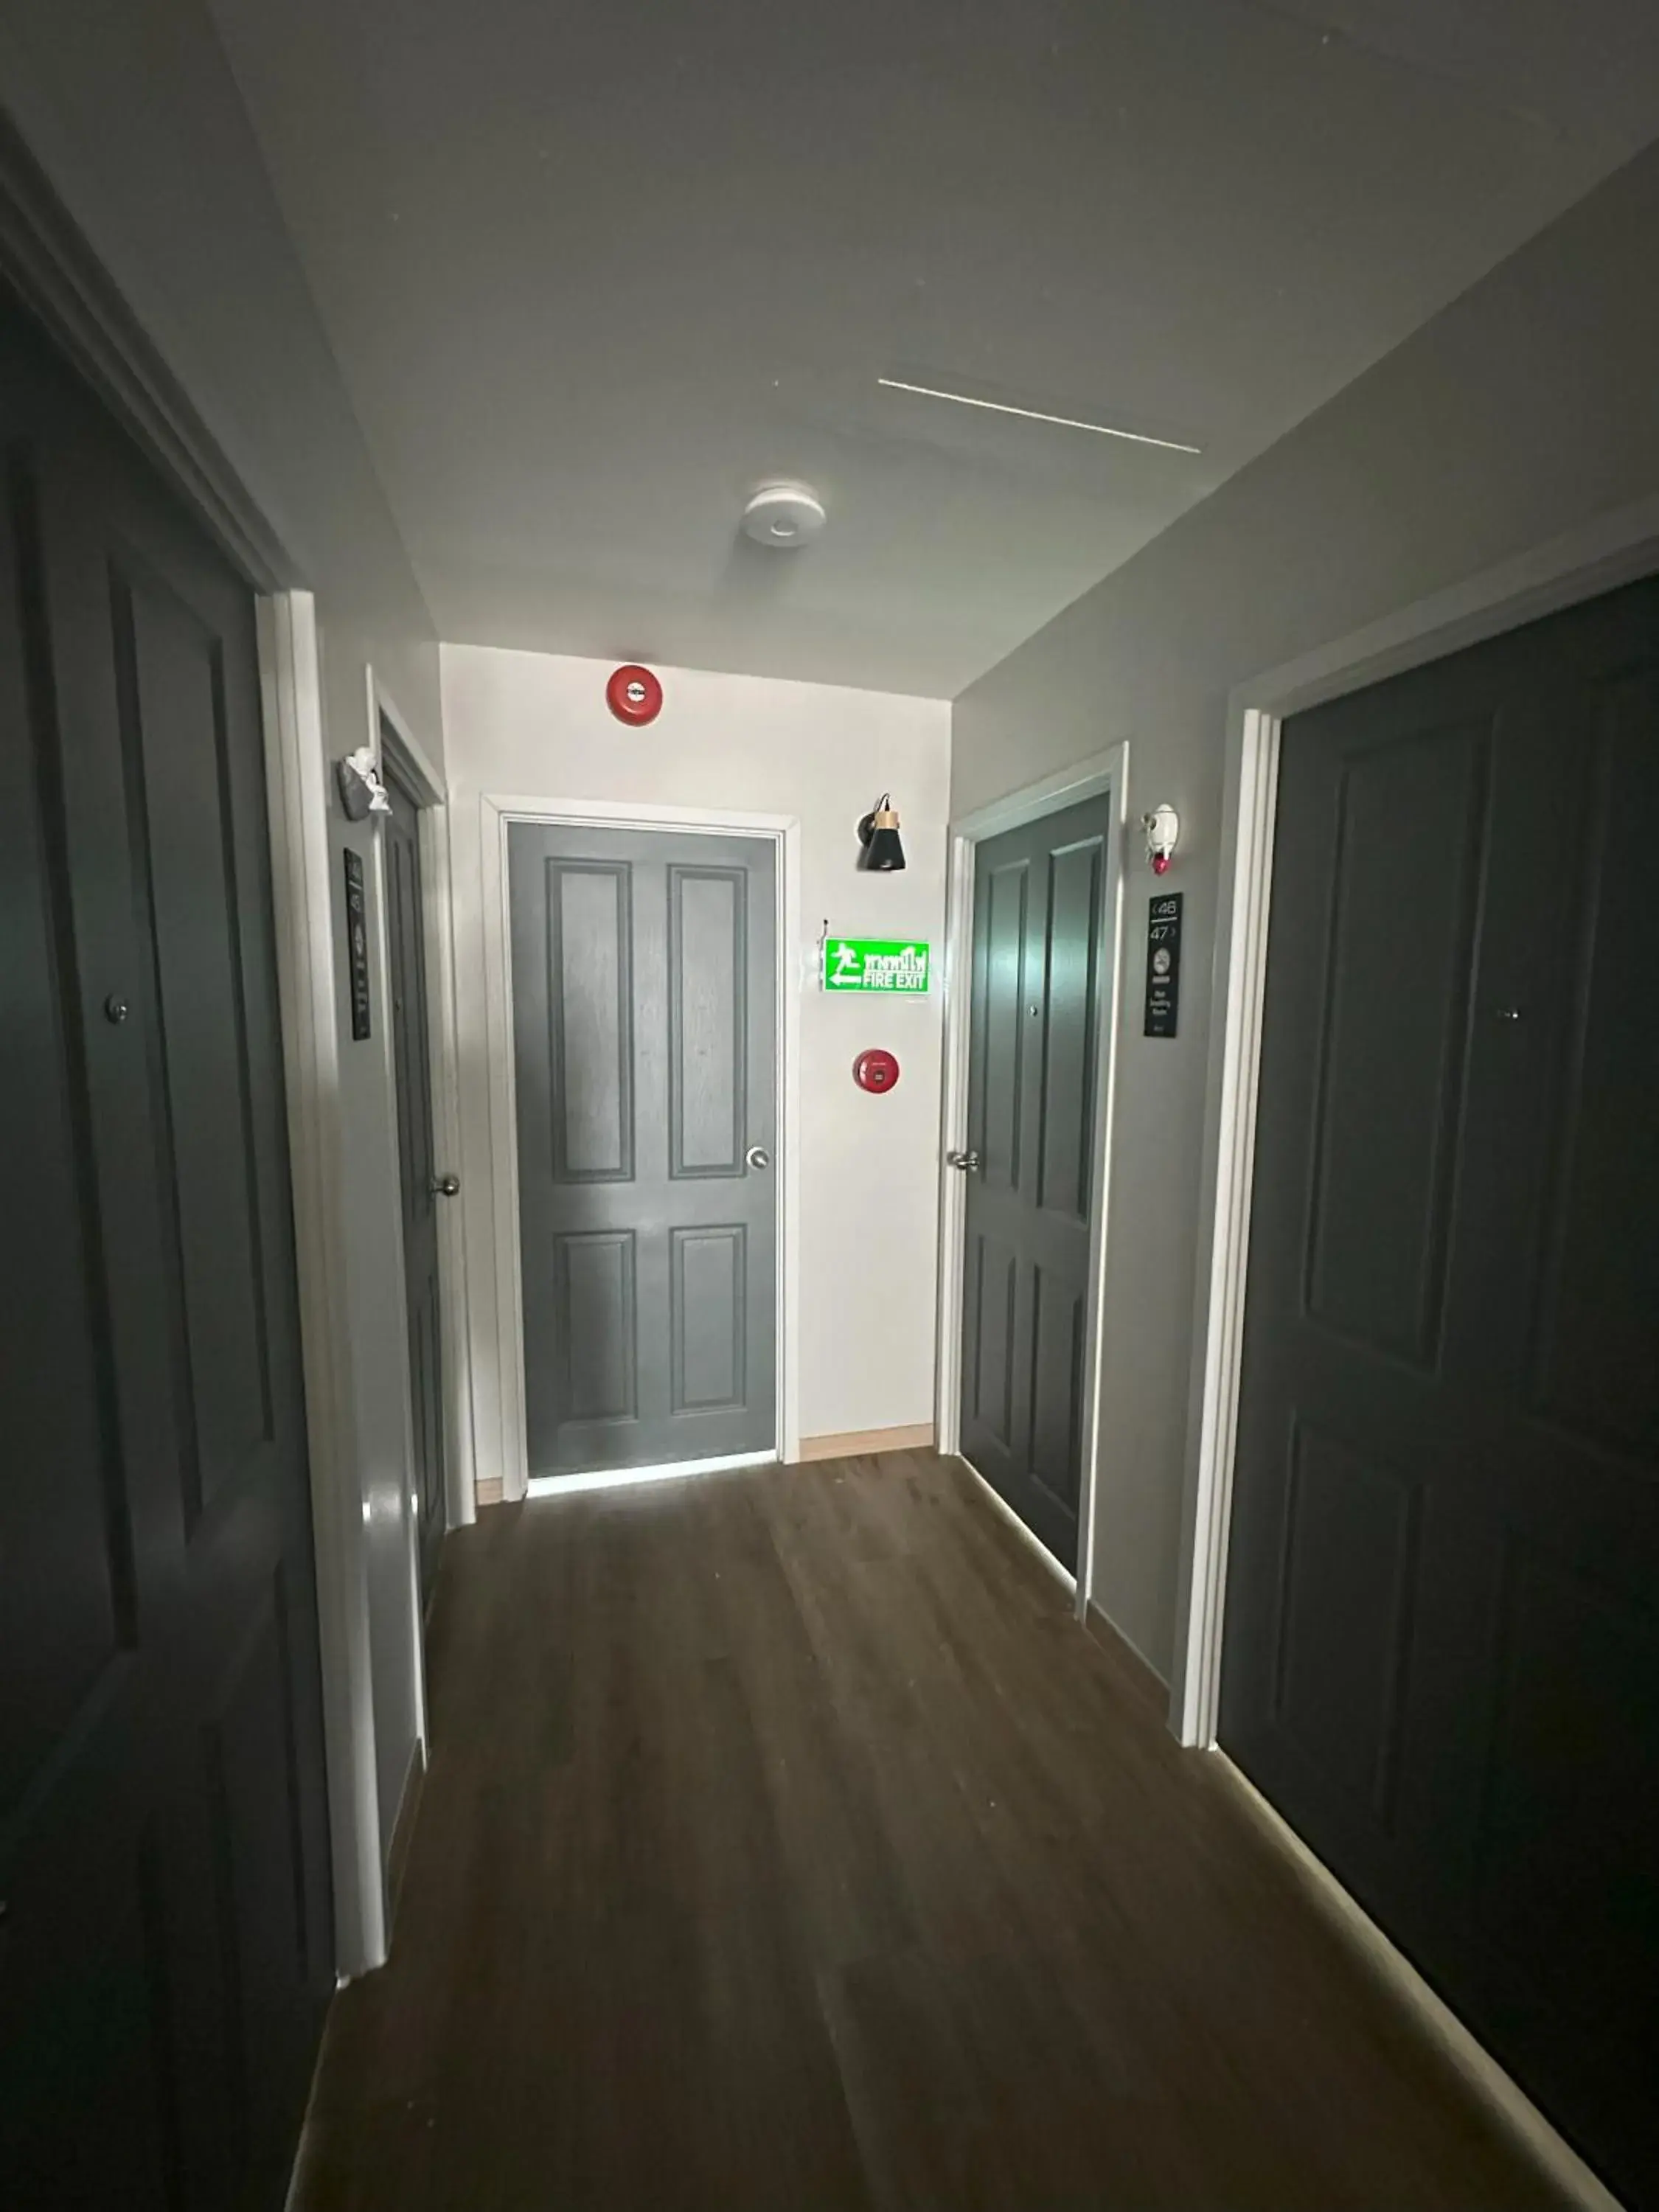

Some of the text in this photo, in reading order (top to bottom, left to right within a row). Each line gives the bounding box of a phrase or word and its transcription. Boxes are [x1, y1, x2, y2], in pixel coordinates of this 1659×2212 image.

[1150, 925, 1169, 941] 47
[863, 971, 925, 990] FIRE EXIT
